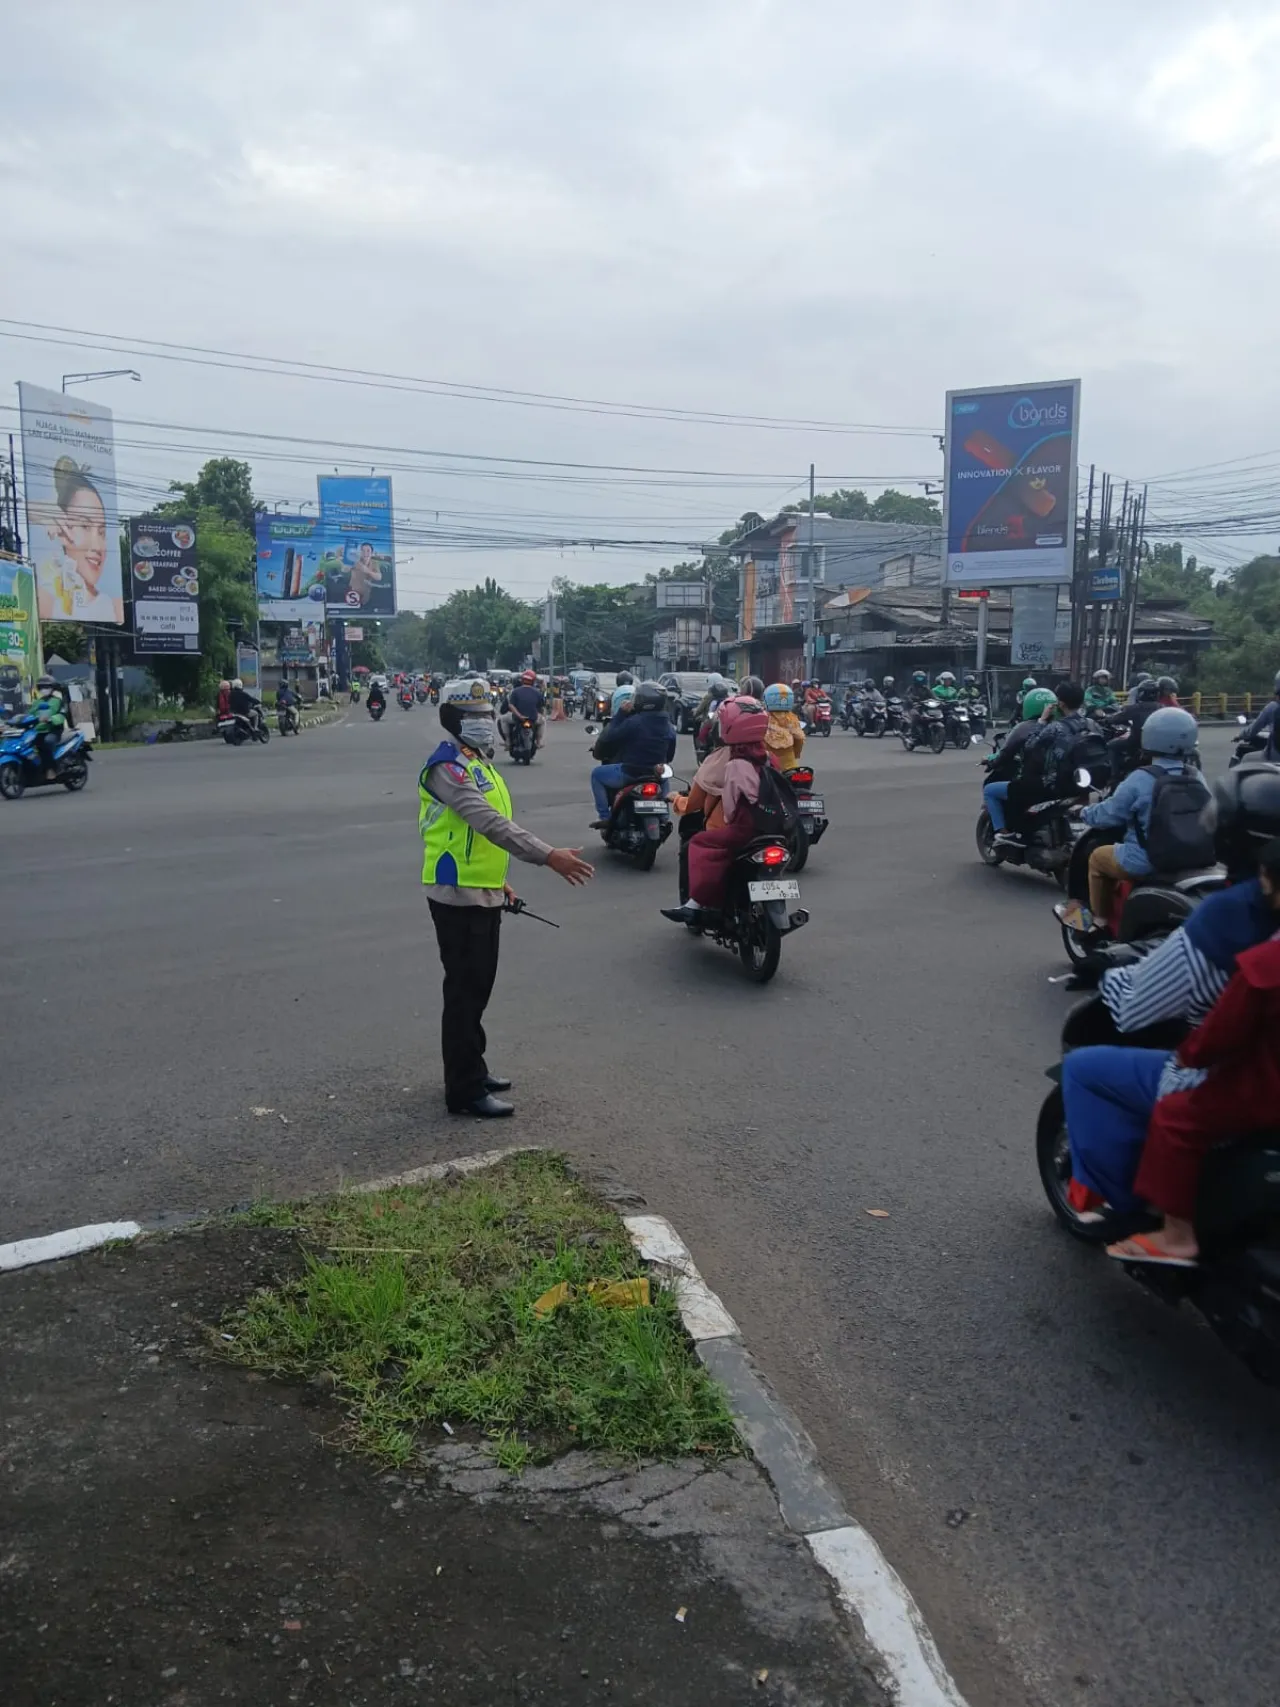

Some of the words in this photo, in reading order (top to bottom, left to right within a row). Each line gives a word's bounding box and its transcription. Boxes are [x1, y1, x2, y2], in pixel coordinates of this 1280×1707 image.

[1019, 401, 1067, 421] bonds
[957, 468, 1012, 479] INNOVATION
[1026, 464, 1061, 475] FLAVOR
[977, 523, 1008, 536] blends
[155, 549, 182, 558] COFFEE
[8, 631, 20, 647] 30
